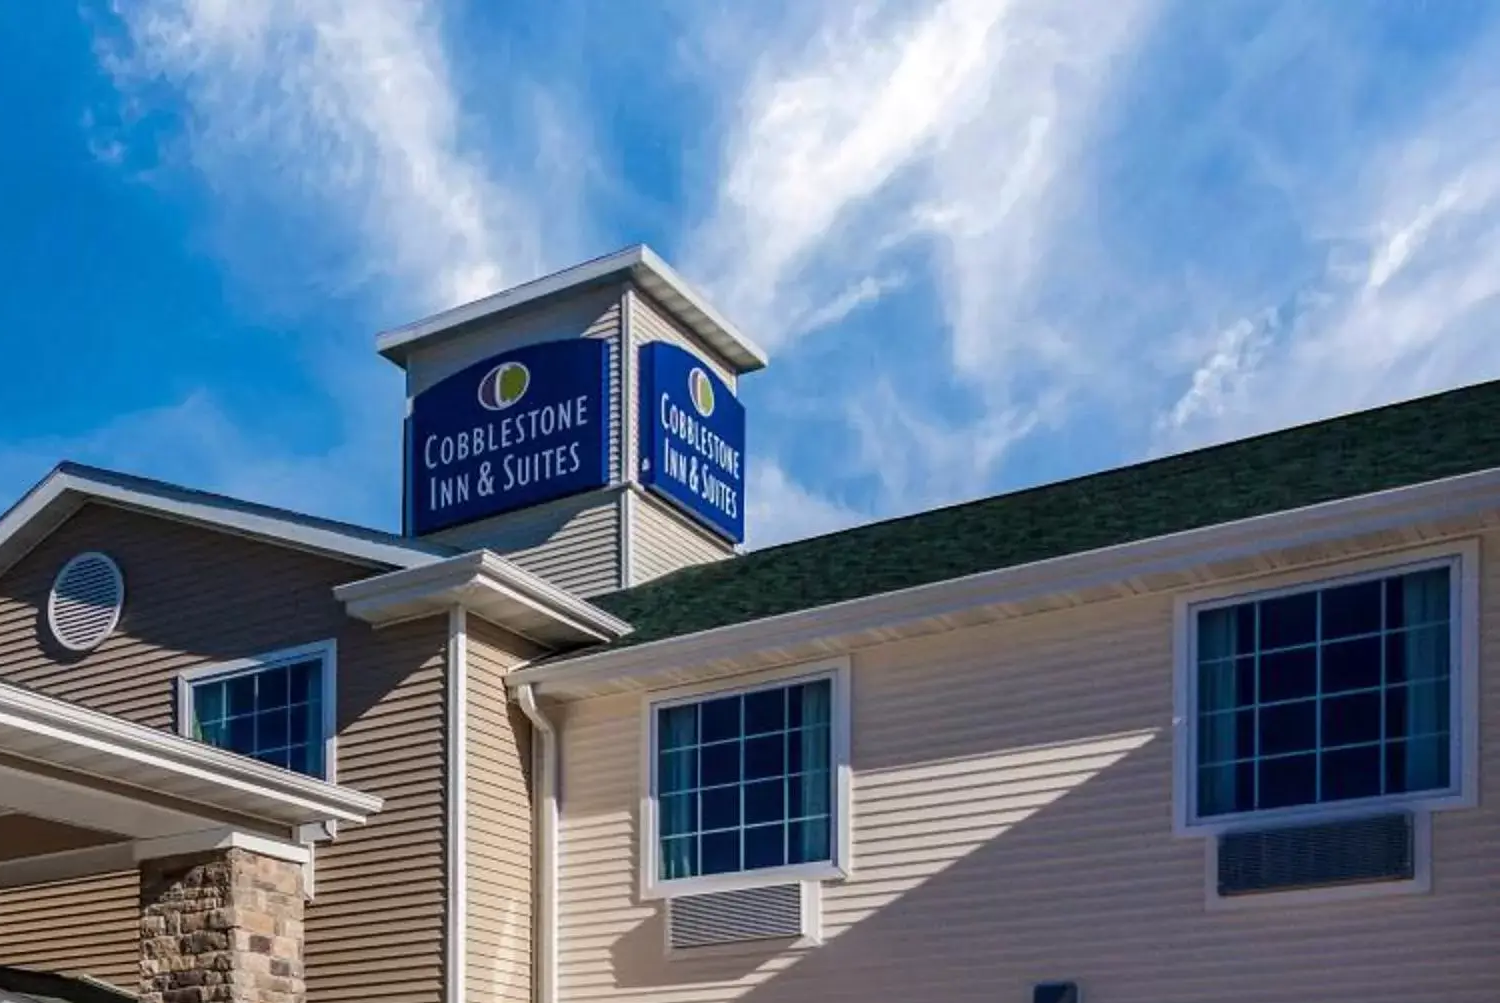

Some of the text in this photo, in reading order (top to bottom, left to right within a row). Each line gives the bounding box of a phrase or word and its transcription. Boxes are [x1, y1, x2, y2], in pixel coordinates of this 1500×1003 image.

[425, 395, 589, 469] COBBLESTONE
[661, 392, 740, 480] COBBLESTONE
[430, 441, 581, 511] INN & SUITES
[664, 437, 737, 519] INN & SUITES
